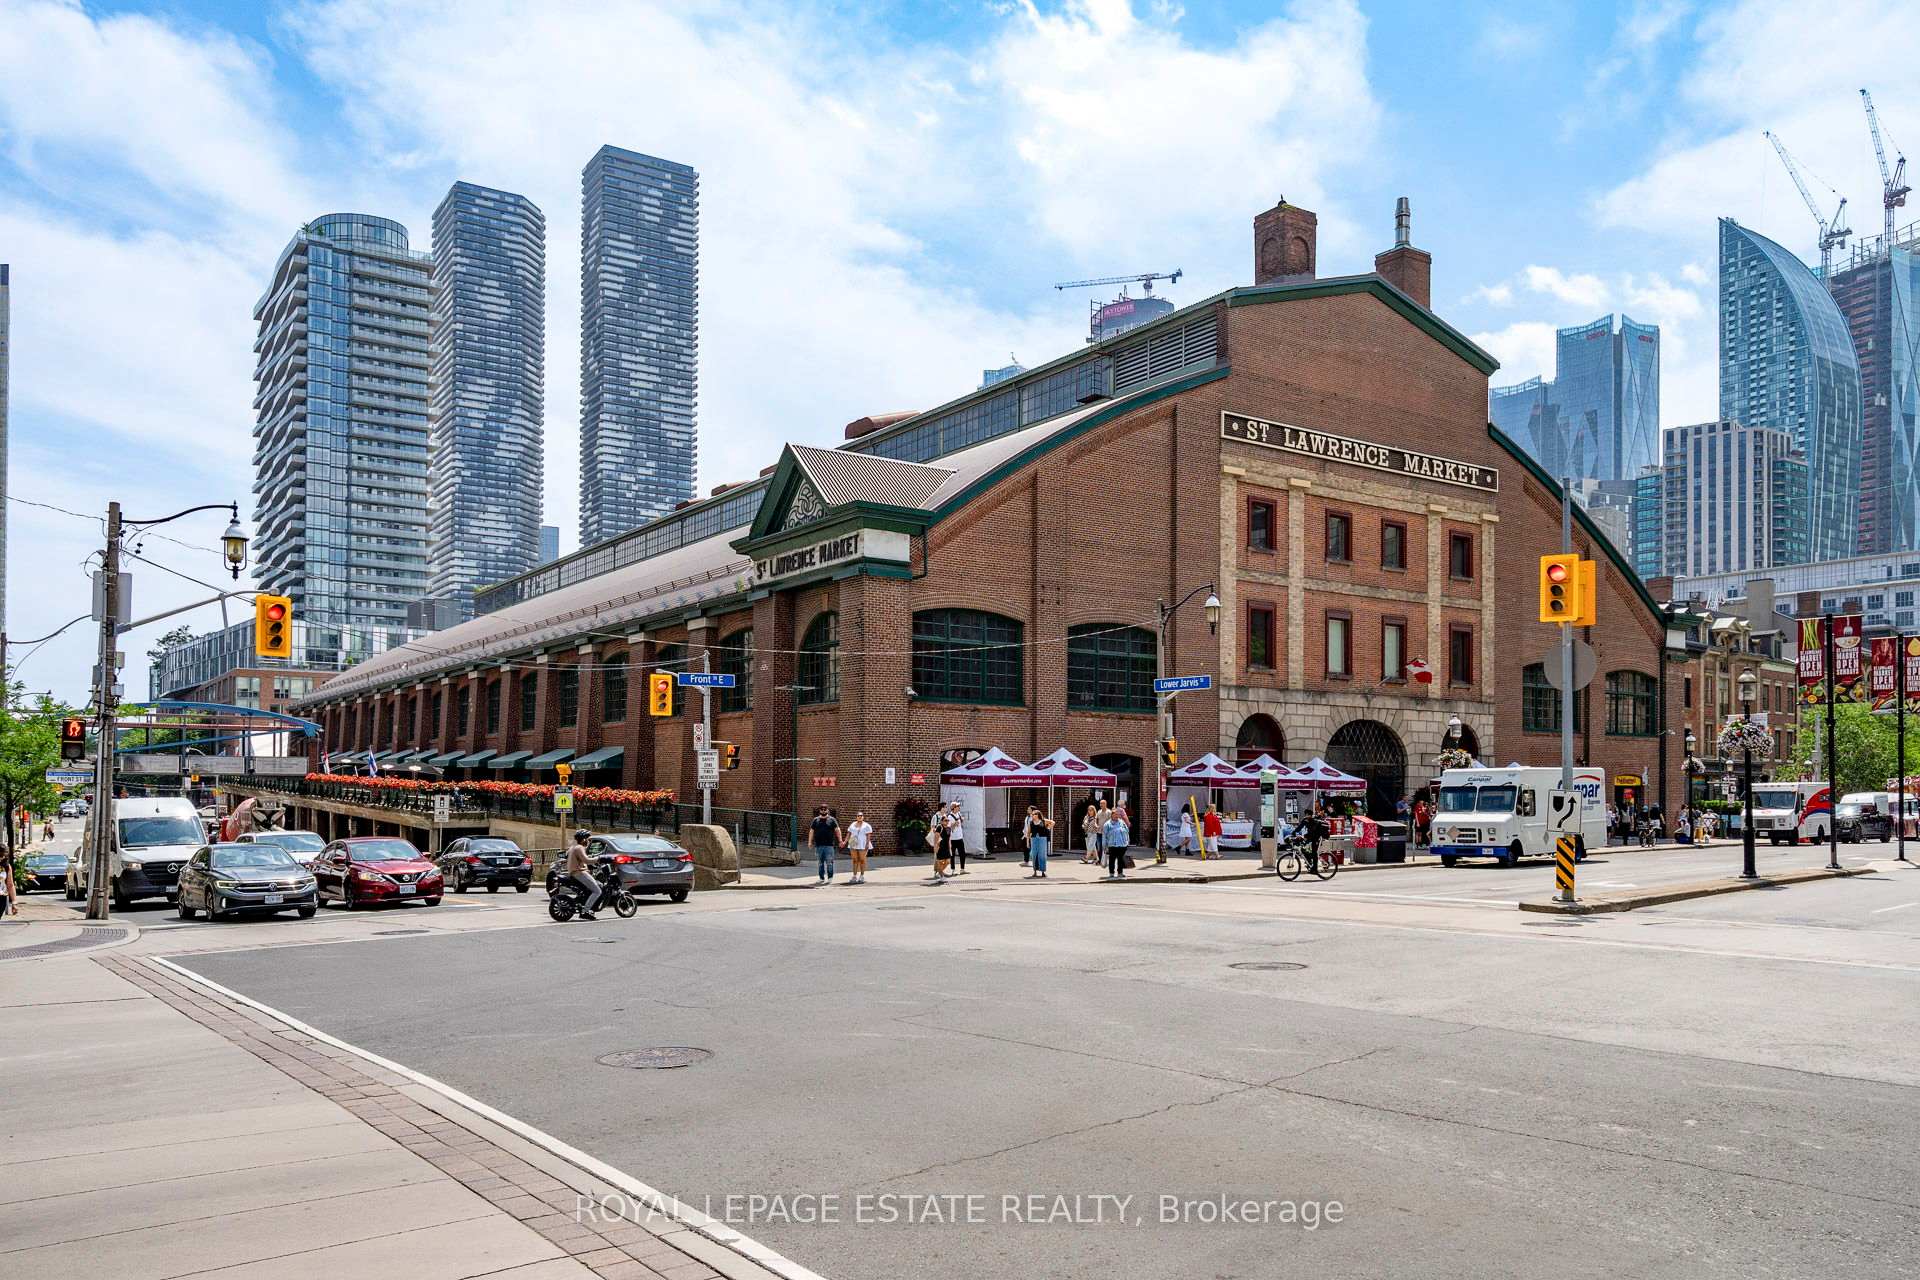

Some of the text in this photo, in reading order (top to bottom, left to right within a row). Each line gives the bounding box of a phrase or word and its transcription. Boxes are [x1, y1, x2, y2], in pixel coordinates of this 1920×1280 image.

[1284, 428, 1389, 467] LAWRENCE
[1403, 453, 1479, 485] MARKET
[769, 547, 816, 577] LAWRENCE
[819, 533, 860, 564] MARKET
[1800, 661, 1822, 671] OPEN
[1837, 659, 1859, 669] OPEN
[690, 675, 711, 684] Front
[719, 676, 724, 684] E
[1160, 680, 1179, 689] Lower
[1180, 678, 1199, 688] Jarvis
[1873, 676, 1894, 685] OPEN
